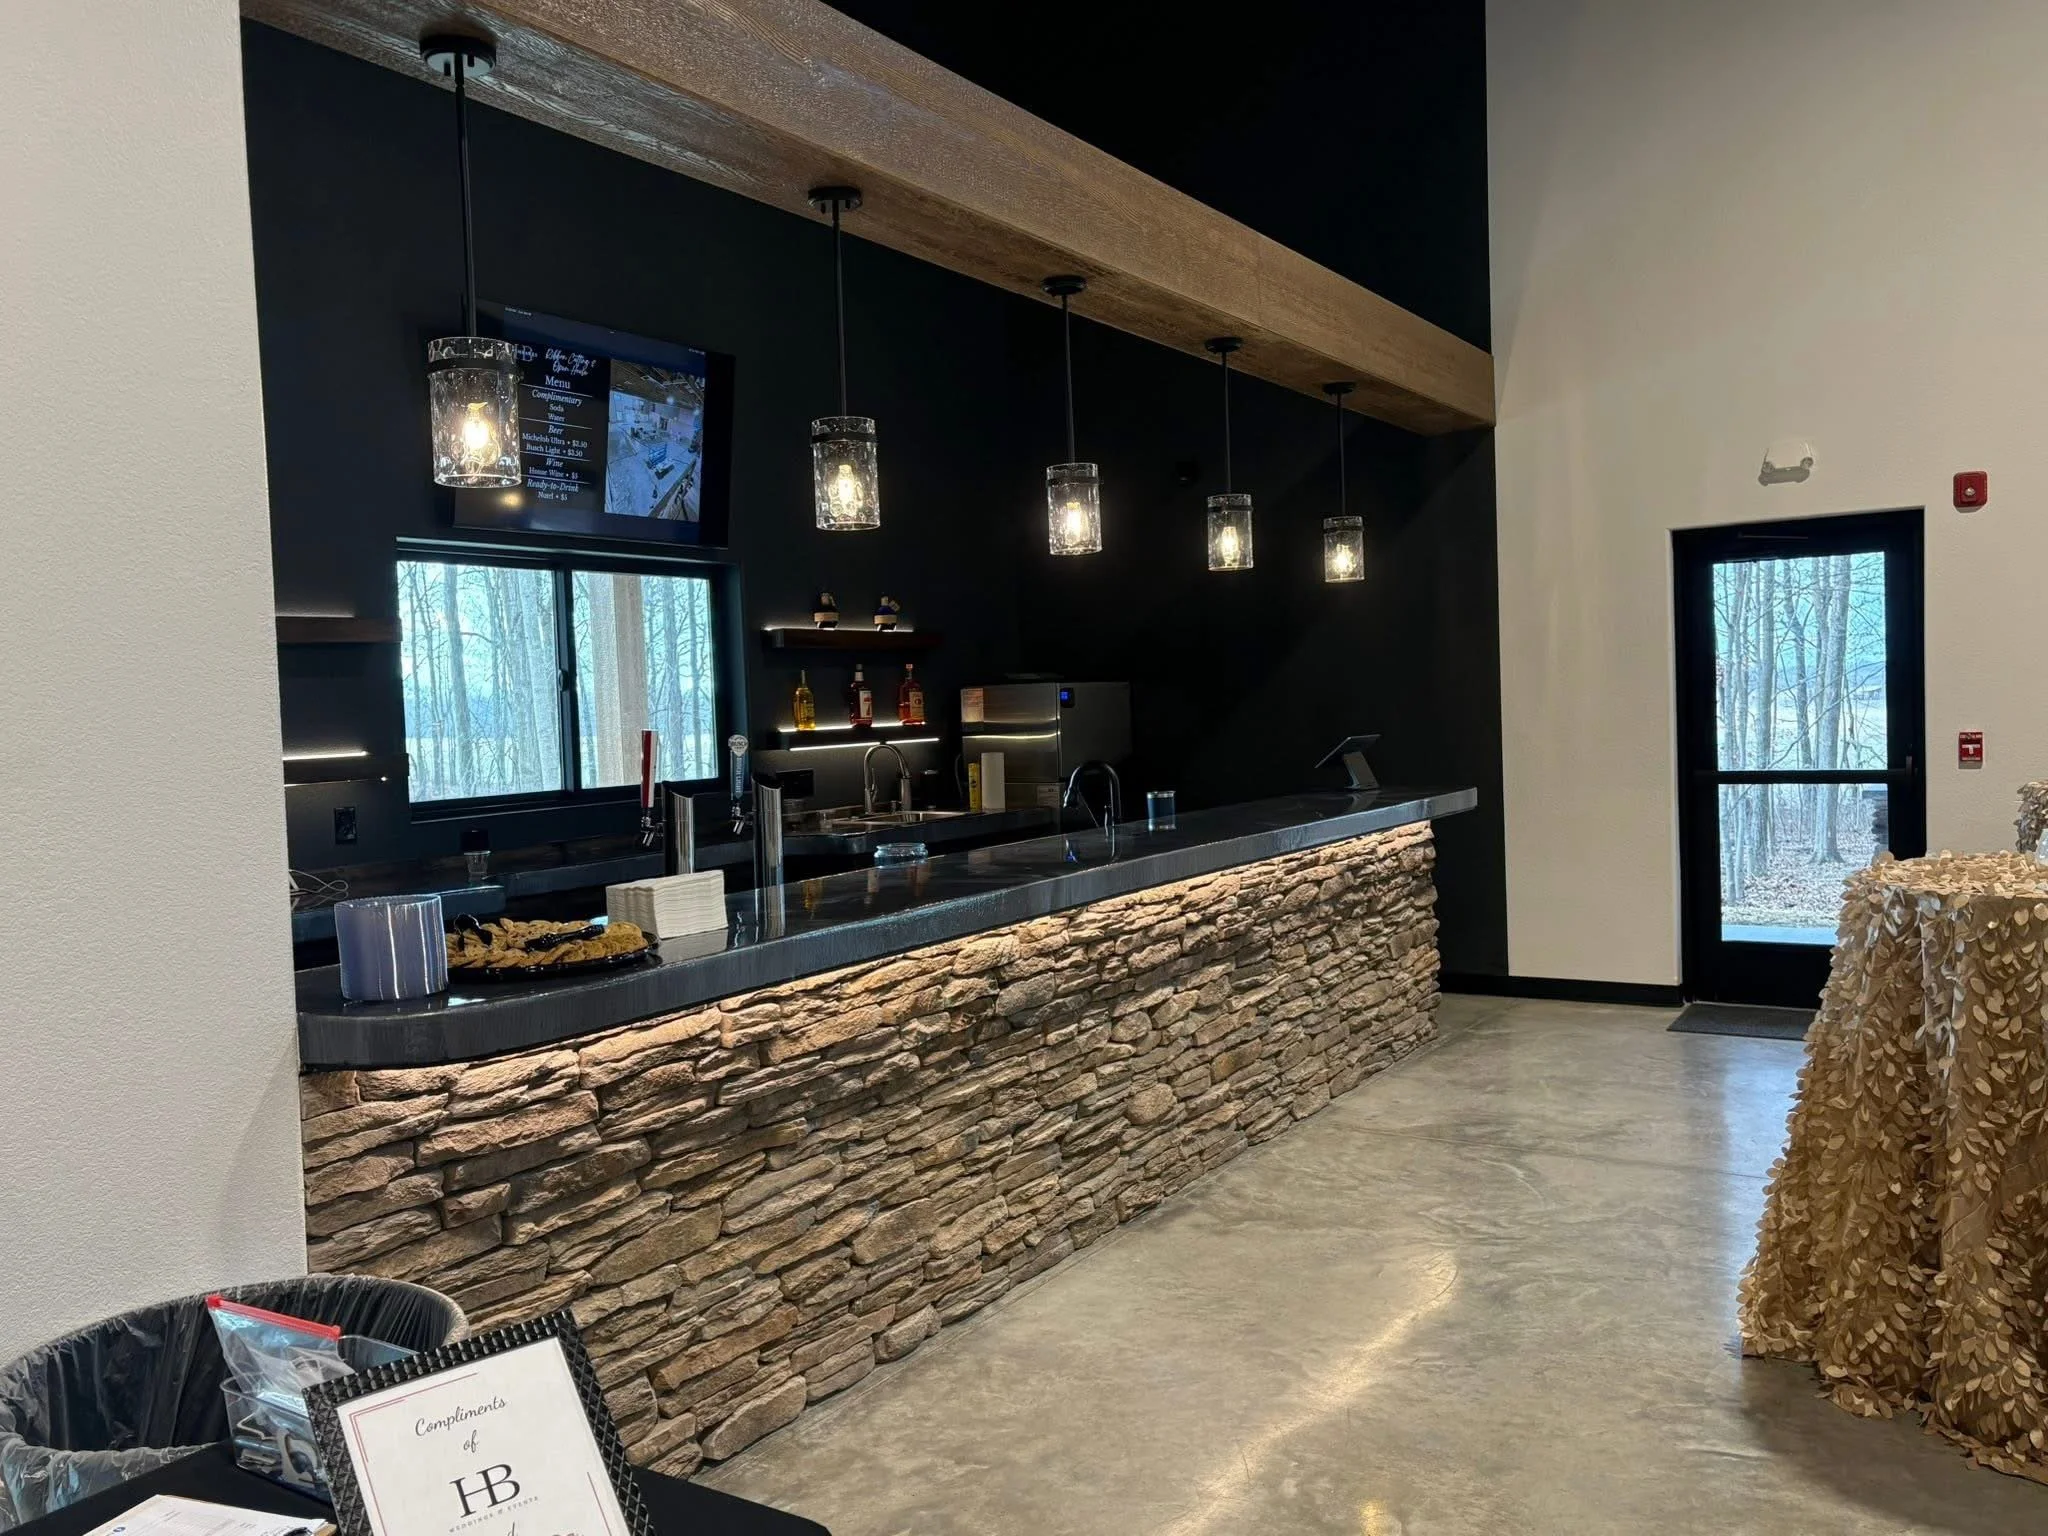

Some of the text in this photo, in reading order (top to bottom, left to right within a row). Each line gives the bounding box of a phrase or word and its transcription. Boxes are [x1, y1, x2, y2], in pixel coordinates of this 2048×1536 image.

[545, 374, 571, 389] Menu
[531, 389, 583, 407] Complimentary
[549, 403, 564, 412] Soda
[548, 412, 565, 422] Water
[548, 425, 564, 434] Beer
[522, 433, 550, 442] Michelob
[550, 436, 566, 445] Ultra
[526, 443, 544, 453] Busch
[545, 447, 561, 455] Light
[546, 457, 563, 467] Wine
[529, 467, 547, 475] House
[549, 469, 564, 478] Wine
[527, 478, 579, 493] Ready-to-Drink
[414, 1396, 507, 1437] Compliments
[462, 1429, 479, 1453] of
[449, 1463, 520, 1518] HB
[448, 1513, 494, 1533] WEDDINGS
[507, 1496, 539, 1512] EVENTS
